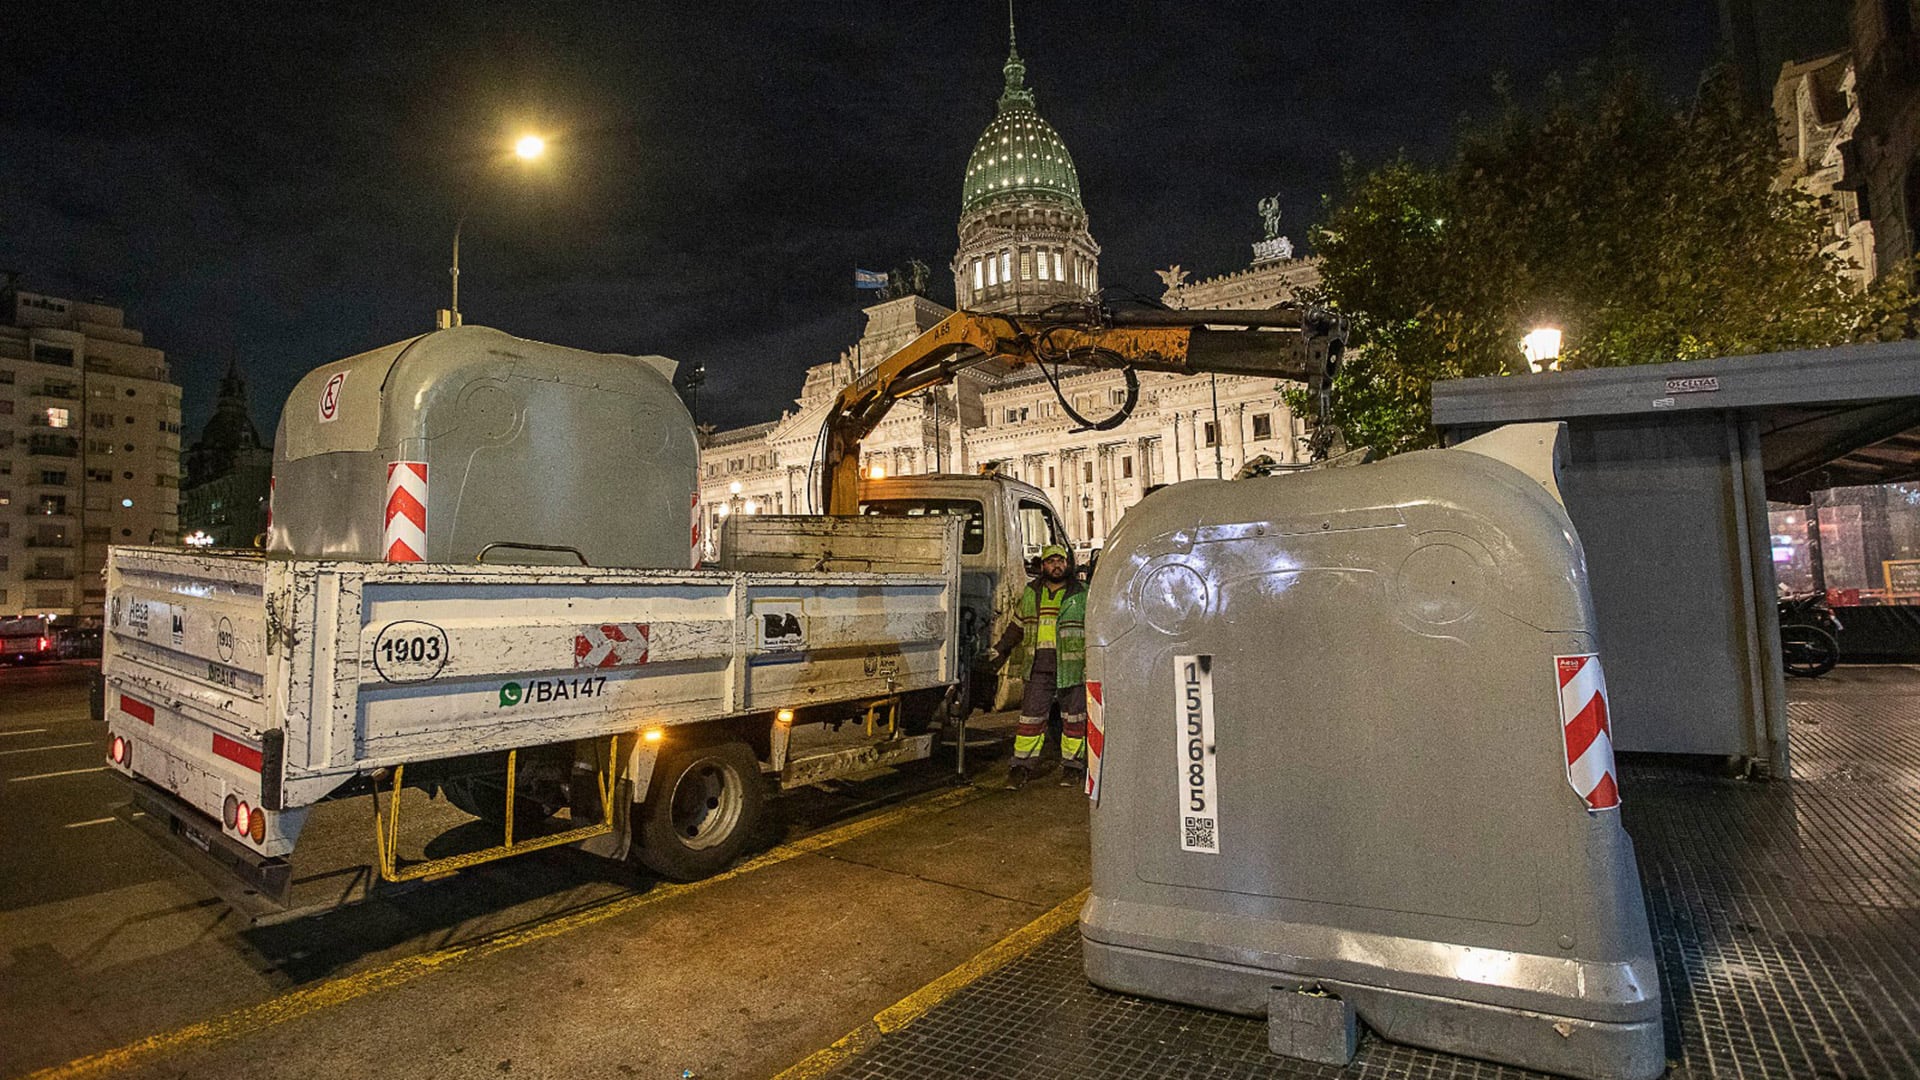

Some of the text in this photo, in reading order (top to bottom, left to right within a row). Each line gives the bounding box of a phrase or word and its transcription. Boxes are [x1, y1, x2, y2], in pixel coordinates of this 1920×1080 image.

[129, 596, 148, 620] Aesa
[763, 613, 802, 638] BA
[382, 636, 440, 662] 1903
[525, 677, 607, 703] /BA147
[1184, 662, 1205, 812] 155685
